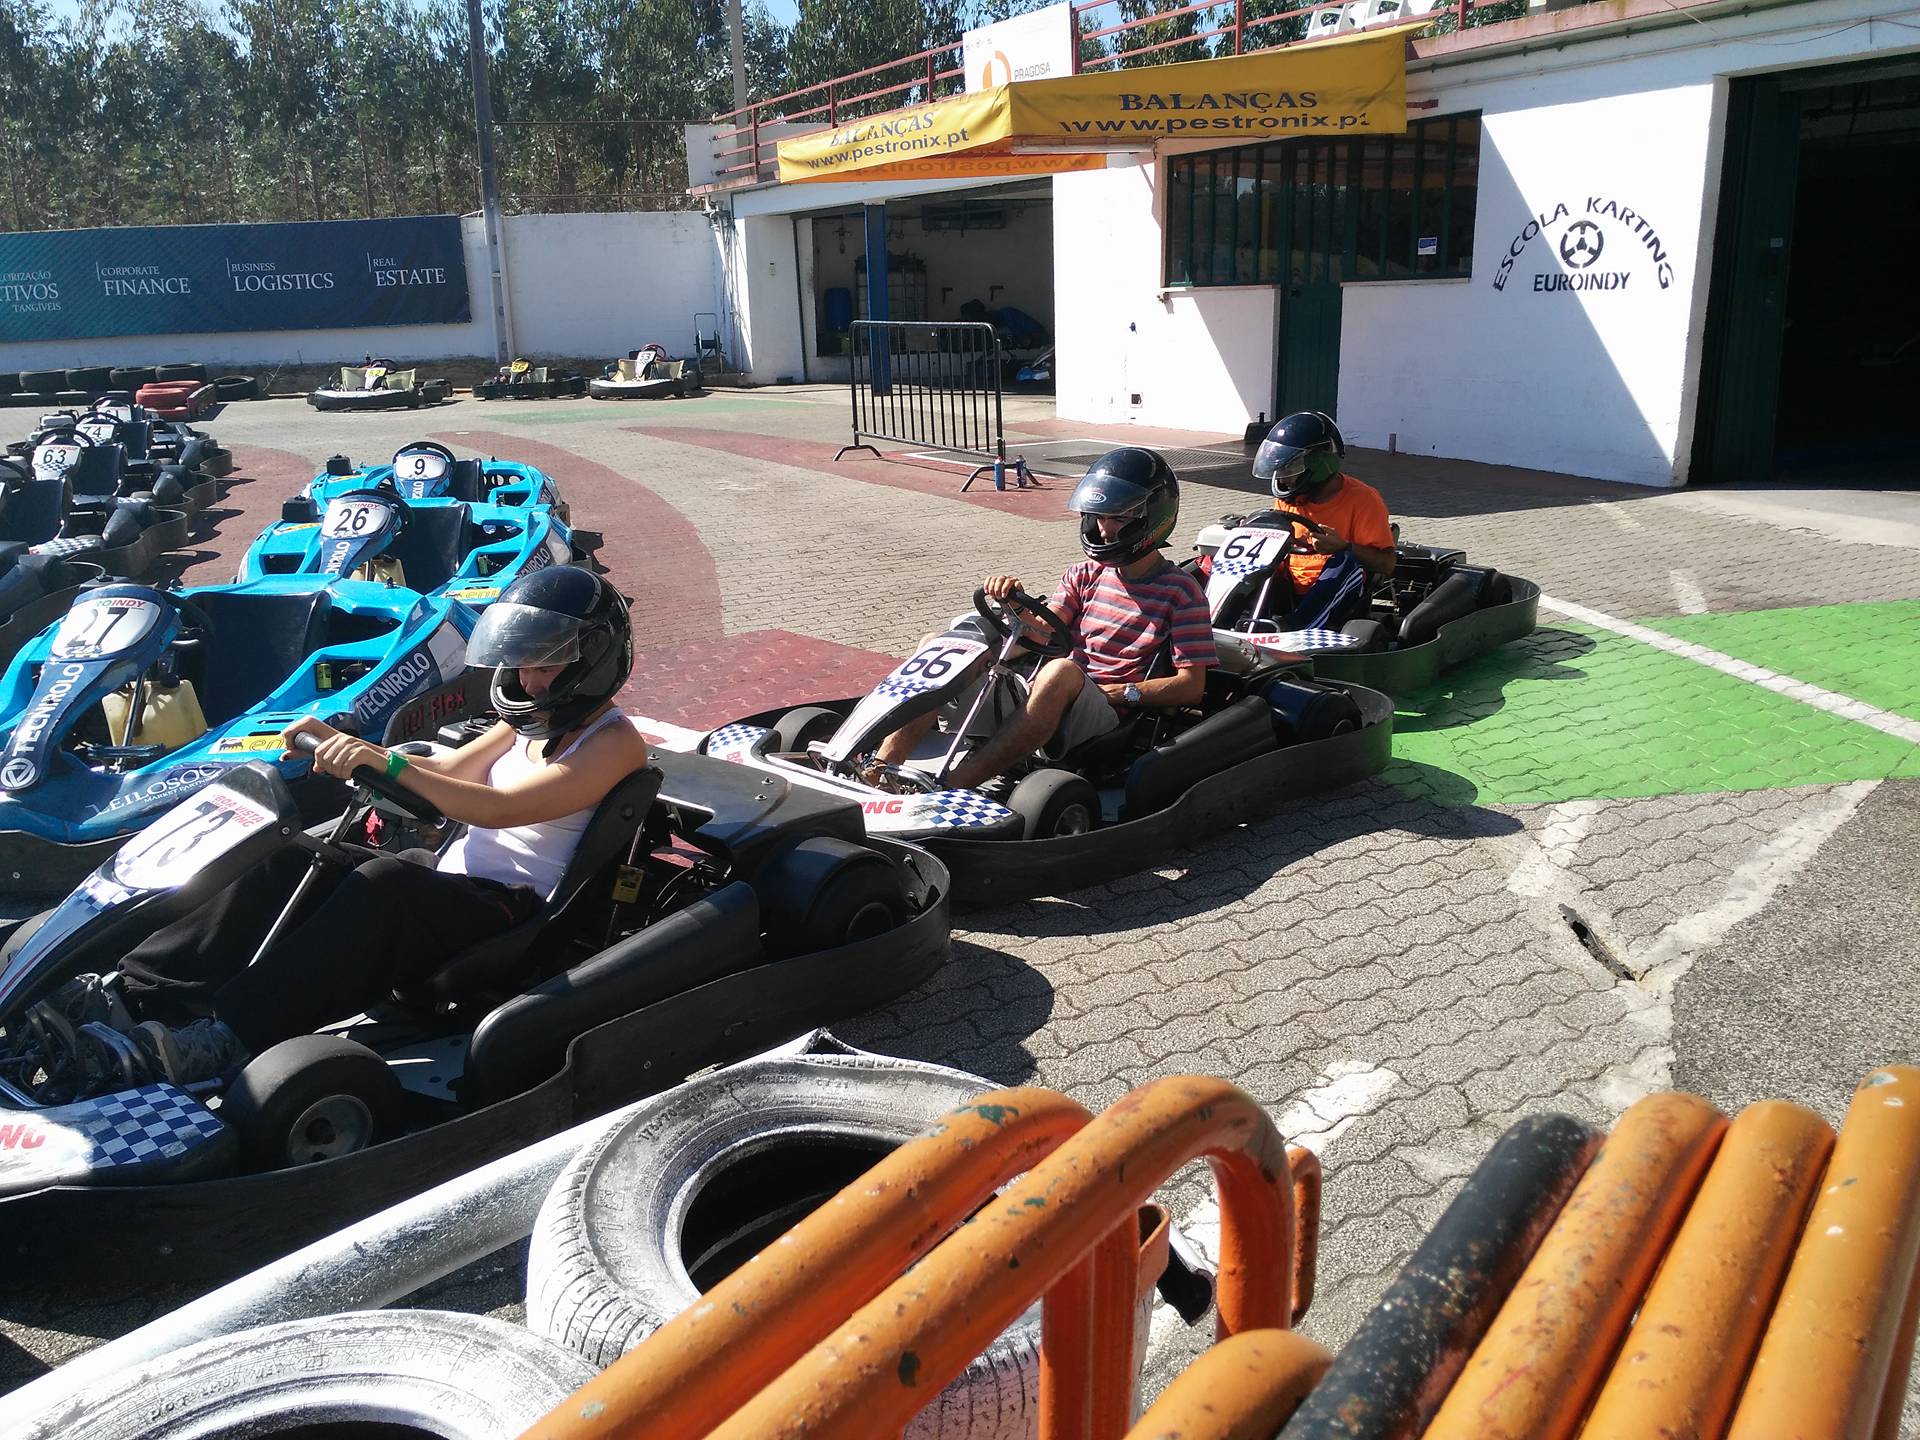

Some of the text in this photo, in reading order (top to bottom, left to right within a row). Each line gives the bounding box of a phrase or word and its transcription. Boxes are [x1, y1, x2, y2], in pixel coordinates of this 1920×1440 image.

[1014, 62, 1051, 80] PRAGOSA
[1118, 92, 1318, 113] BALANÇAS
[807, 127, 970, 169] www.pestronix.pt
[1492, 196, 1675, 291] ESCOLA KARTING
[101, 265, 160, 277] CORPORATE
[231, 262, 276, 273] BUSINESS
[372, 257, 397, 268] REAL
[104, 277, 191, 297] FINANCE
[233, 272, 334, 293] LOGISTICS
[375, 267, 447, 288] ESTATE
[1533, 271, 1632, 292] EUROINDY
[0, 283, 59, 302] TIVOS
[43, 449, 67, 464] 63
[414, 458, 425, 476] 9
[333, 507, 370, 531] 26
[1223, 535, 1268, 565] 64
[65, 607, 130, 647] 27
[900, 646, 968, 679] 66
[358, 652, 431, 726] TECNIROLO
[12, 663, 84, 757] TECNIROLO
[137, 801, 236, 868] 73
